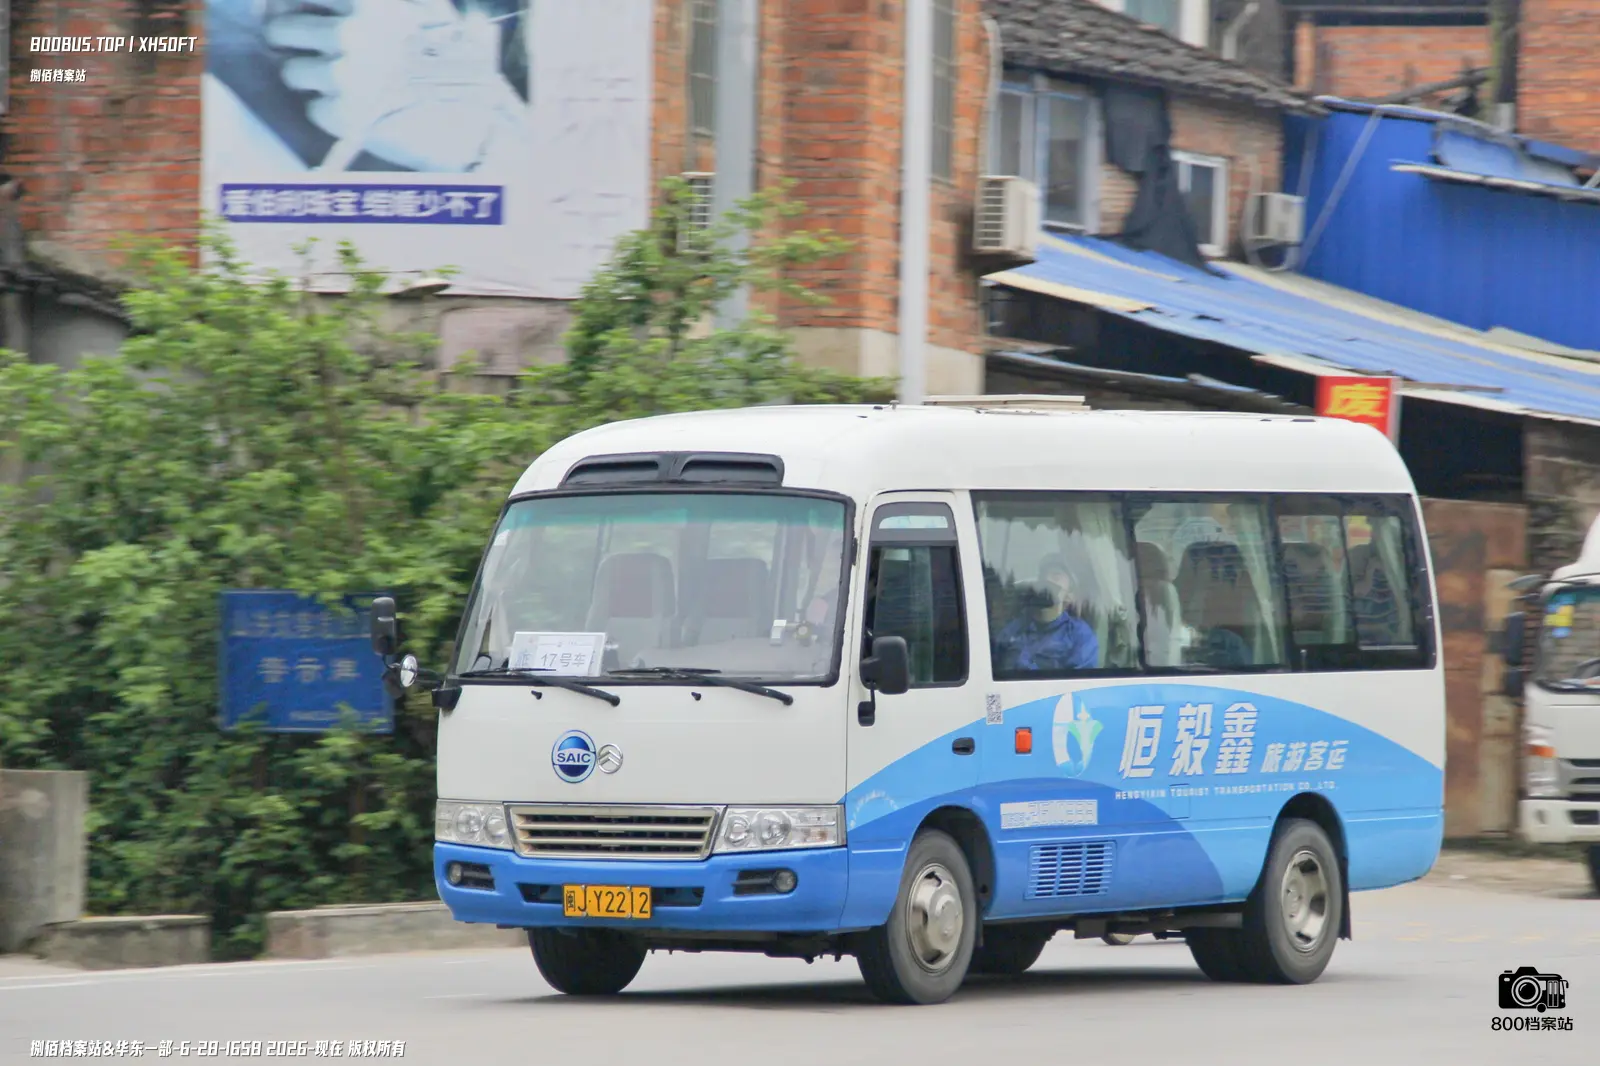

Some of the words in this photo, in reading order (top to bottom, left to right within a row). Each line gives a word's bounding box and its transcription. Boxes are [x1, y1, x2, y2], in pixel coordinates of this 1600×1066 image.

[541, 652, 586, 668] 17号车
[1119, 702, 1258, 779] 恒毅鑫
[1261, 740, 1349, 773] 旅游客运
[557, 753, 591, 763] SAIC
[1170, 787, 1209, 797] TOURIST
